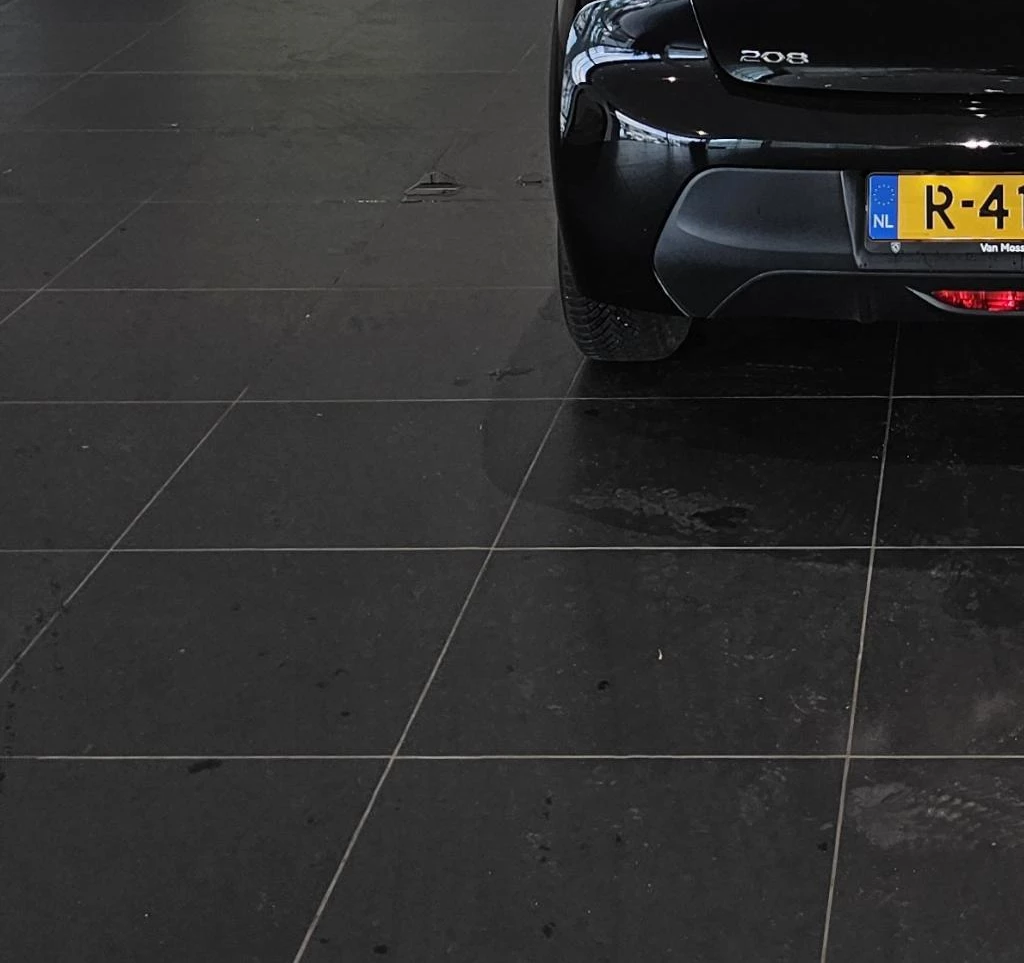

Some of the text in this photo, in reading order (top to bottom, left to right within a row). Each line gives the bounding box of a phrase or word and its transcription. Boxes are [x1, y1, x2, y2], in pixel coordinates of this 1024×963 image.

[740, 50, 809, 64] 208
[873, 213, 894, 228] NL
[980, 242, 998, 252] Van
